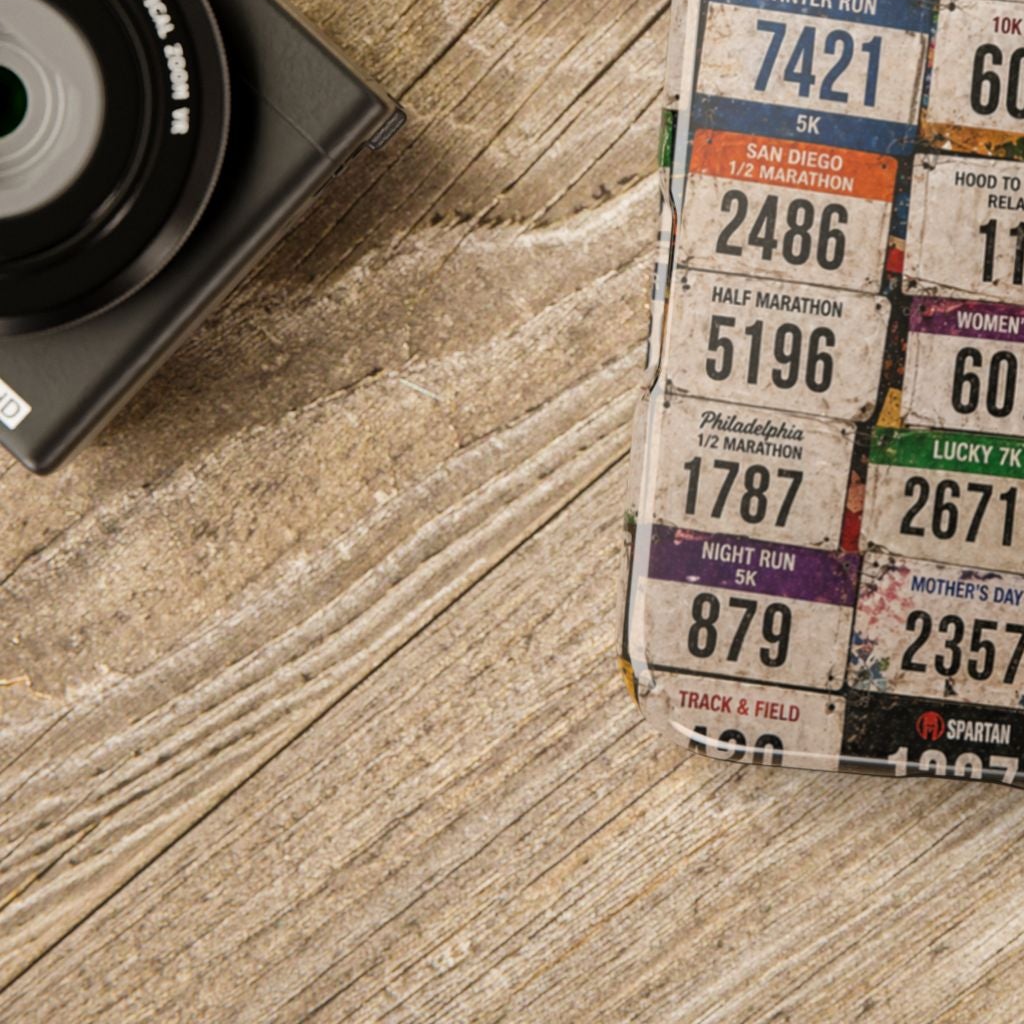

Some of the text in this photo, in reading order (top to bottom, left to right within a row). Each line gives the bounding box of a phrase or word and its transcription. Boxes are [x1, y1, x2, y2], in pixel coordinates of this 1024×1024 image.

[992, 16, 1023, 36] 10K
[163, 42, 190, 100] ZOOM
[753, 19, 883, 107] 7421
[795, 114, 821, 135] 5K
[746, 142, 843, 172] SAN DIEGO
[729, 160, 855, 192] 1/2 MARATHON
[954, 171, 997, 189] HOOD
[1003, 175, 1021, 192] TO
[715, 189, 848, 270] 2486
[712, 286, 844, 318] HALF MARATHON
[705, 314, 836, 393] 5196
[699, 410, 805, 442] Philadelphia
[698, 433, 803, 460] 1/2 MARATHON
[932, 439, 1023, 468] LUCKY 7K
[683, 456, 804, 528] 1787
[900, 475, 1018, 547] 2671
[701, 541, 796, 572] NIGHT RUN
[734, 568, 758, 587] 5K
[911, 575, 989, 602] MOTHER'S
[993, 589, 1024, 607] DAY
[687, 592, 792, 668] 879
[679, 689, 800, 723] TRACK & FIELD
[946, 718, 1012, 745] SPARTAN
